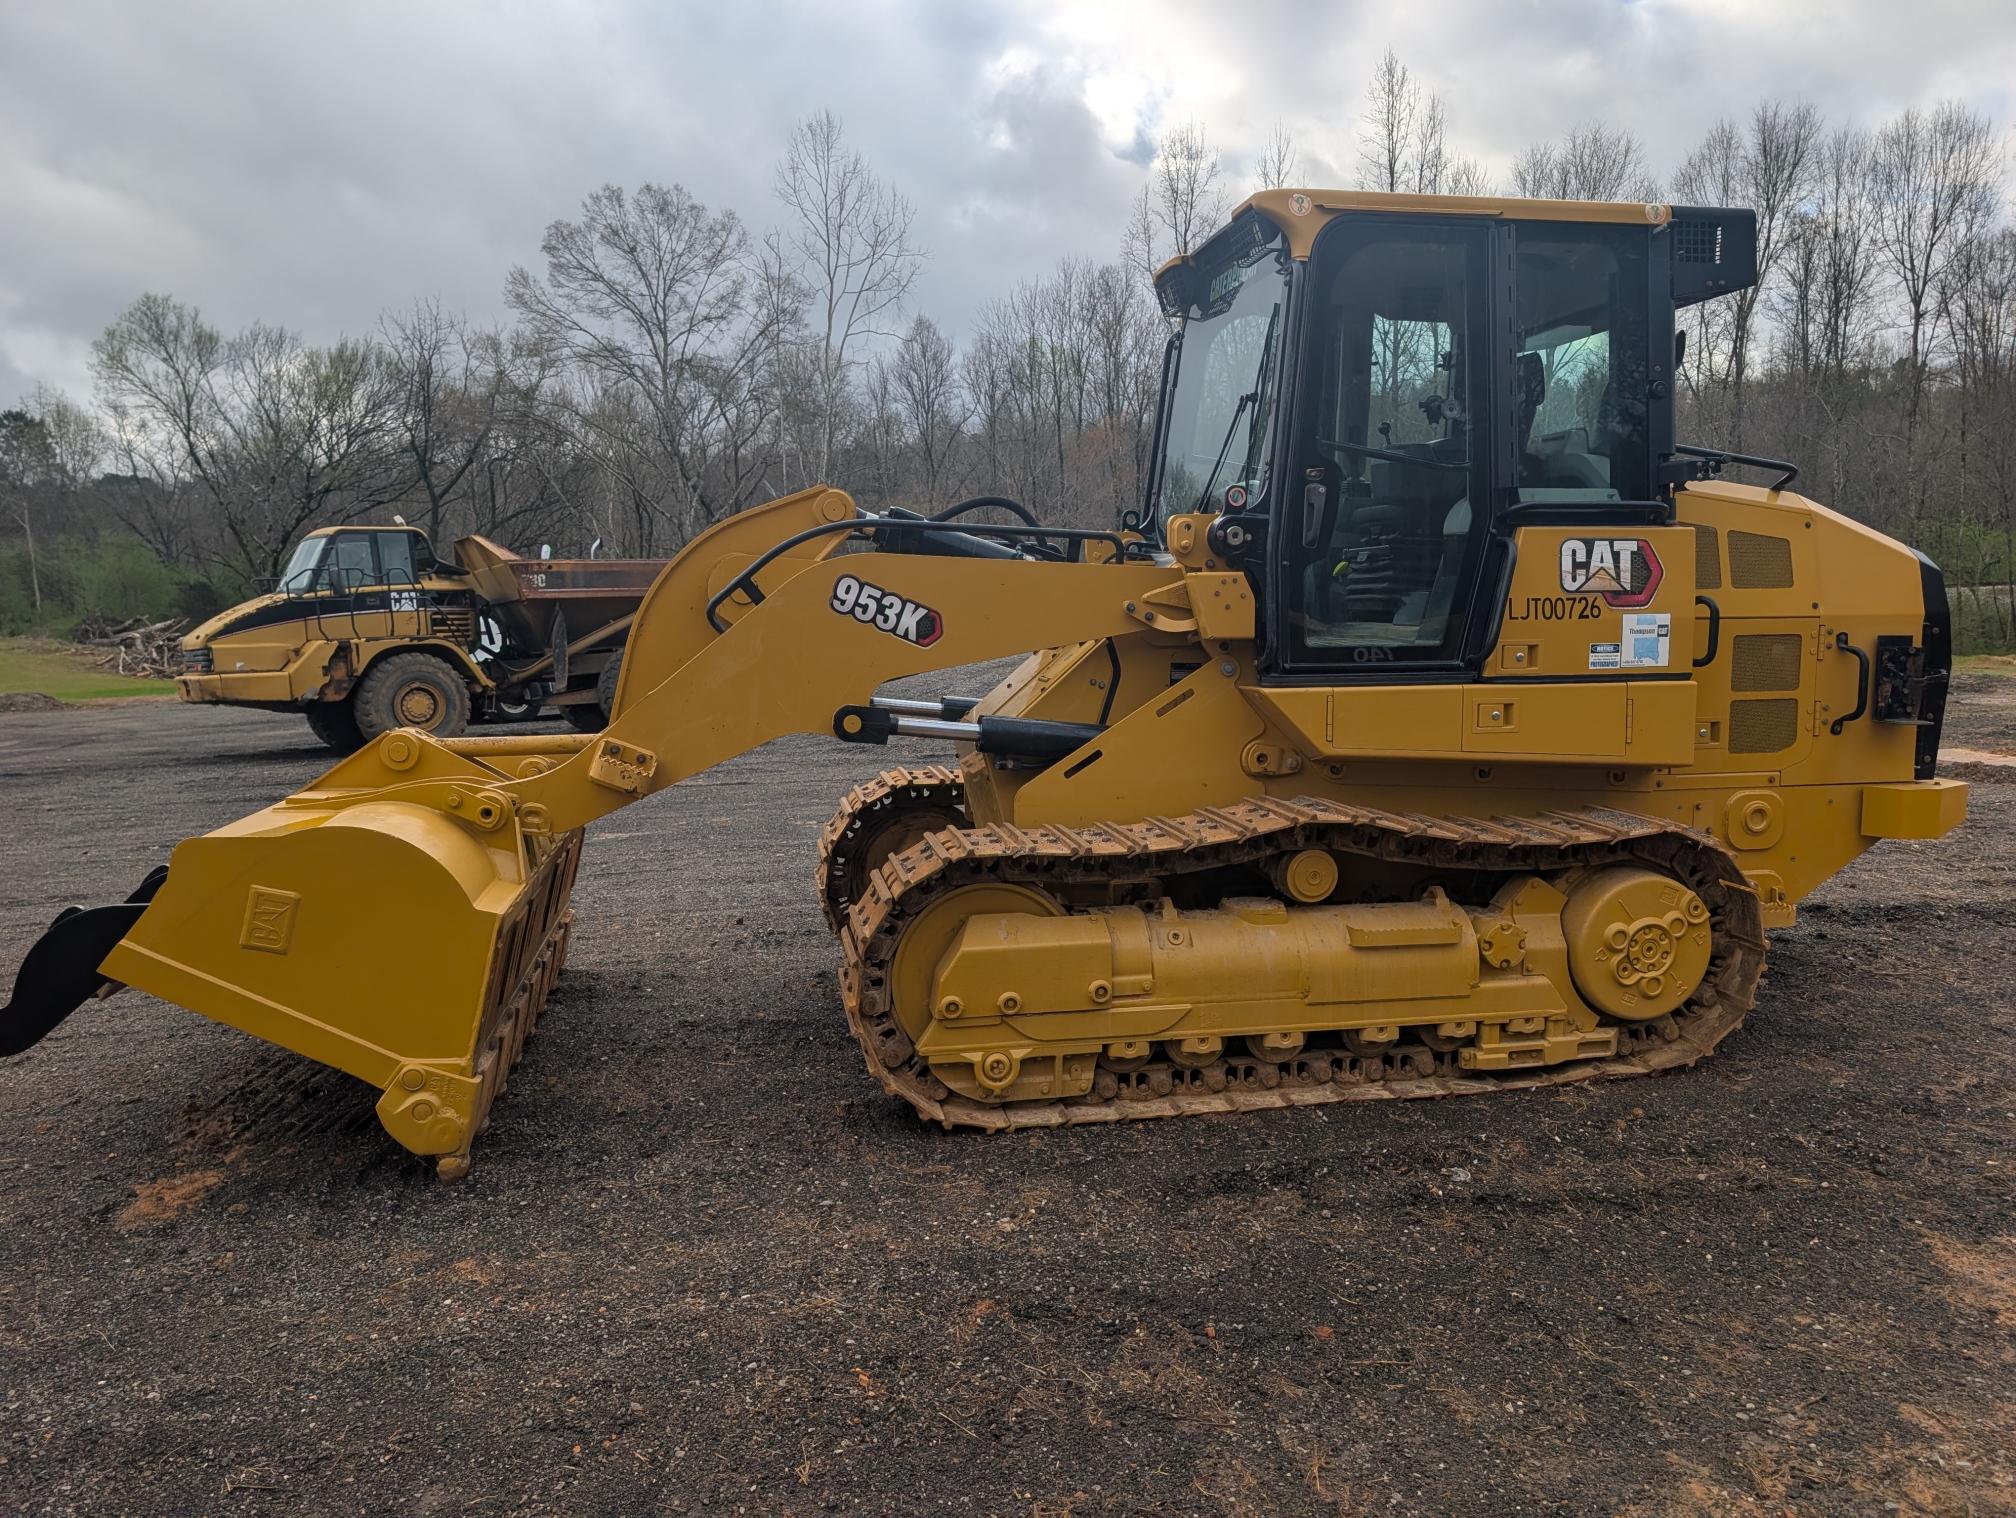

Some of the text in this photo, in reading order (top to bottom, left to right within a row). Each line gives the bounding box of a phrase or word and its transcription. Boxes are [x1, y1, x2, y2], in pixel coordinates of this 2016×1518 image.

[1561, 539, 1638, 592] CAT
[390, 591, 417, 612] CAT
[832, 576, 929, 642] 953K
[1508, 597, 1602, 621] LJT00726
[251, 893, 289, 948] CAT
